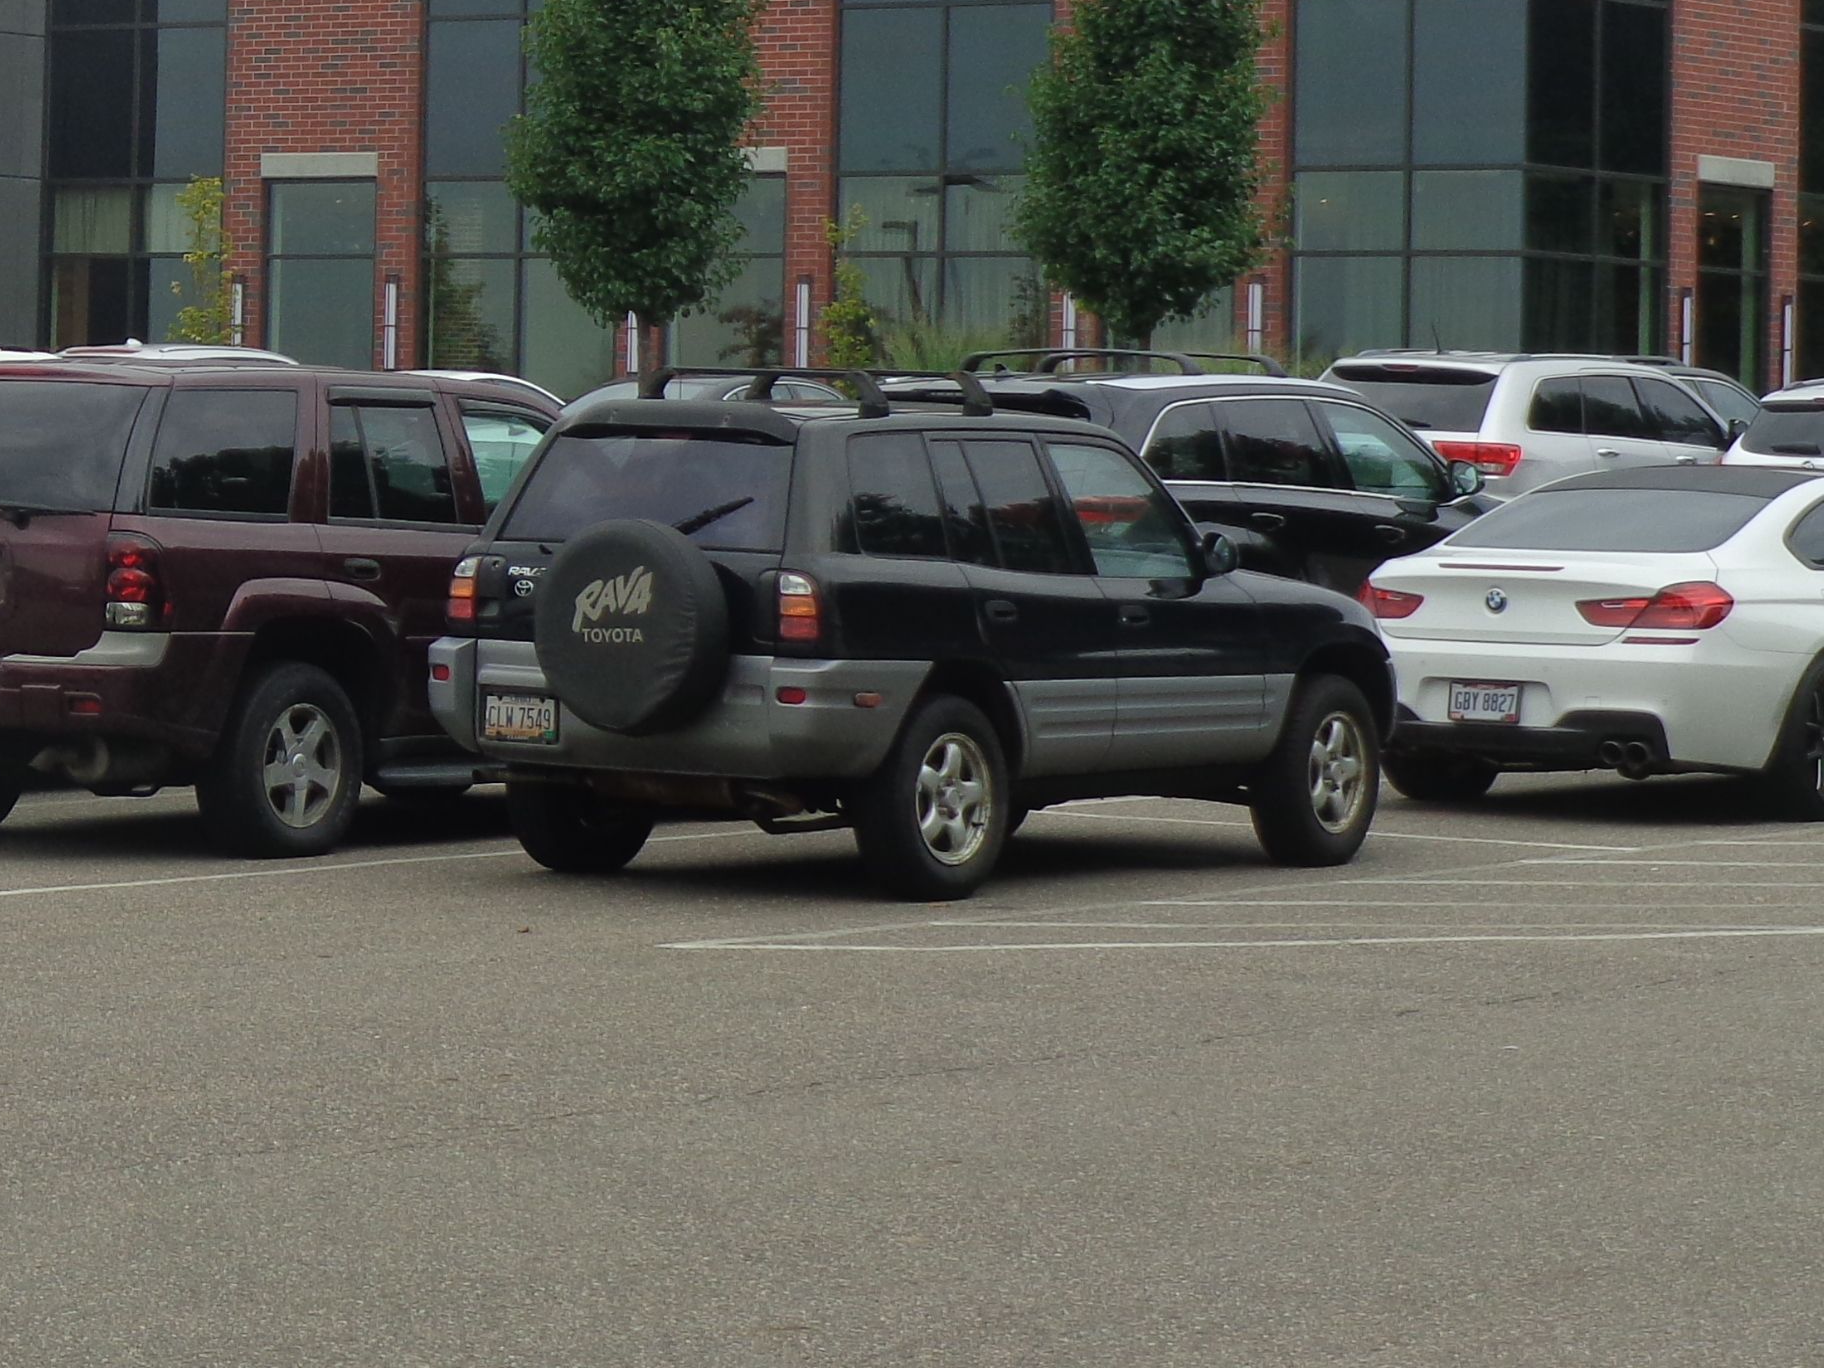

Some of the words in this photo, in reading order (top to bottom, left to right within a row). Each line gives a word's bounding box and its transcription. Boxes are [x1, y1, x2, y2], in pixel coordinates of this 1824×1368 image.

[571, 565, 653, 633] RAV4
[581, 627, 644, 643] TOYOTA
[1454, 691, 1479, 711] GBY
[1482, 693, 1515, 713] 8827
[488, 705, 514, 728] CLW
[518, 707, 551, 730] 7549
